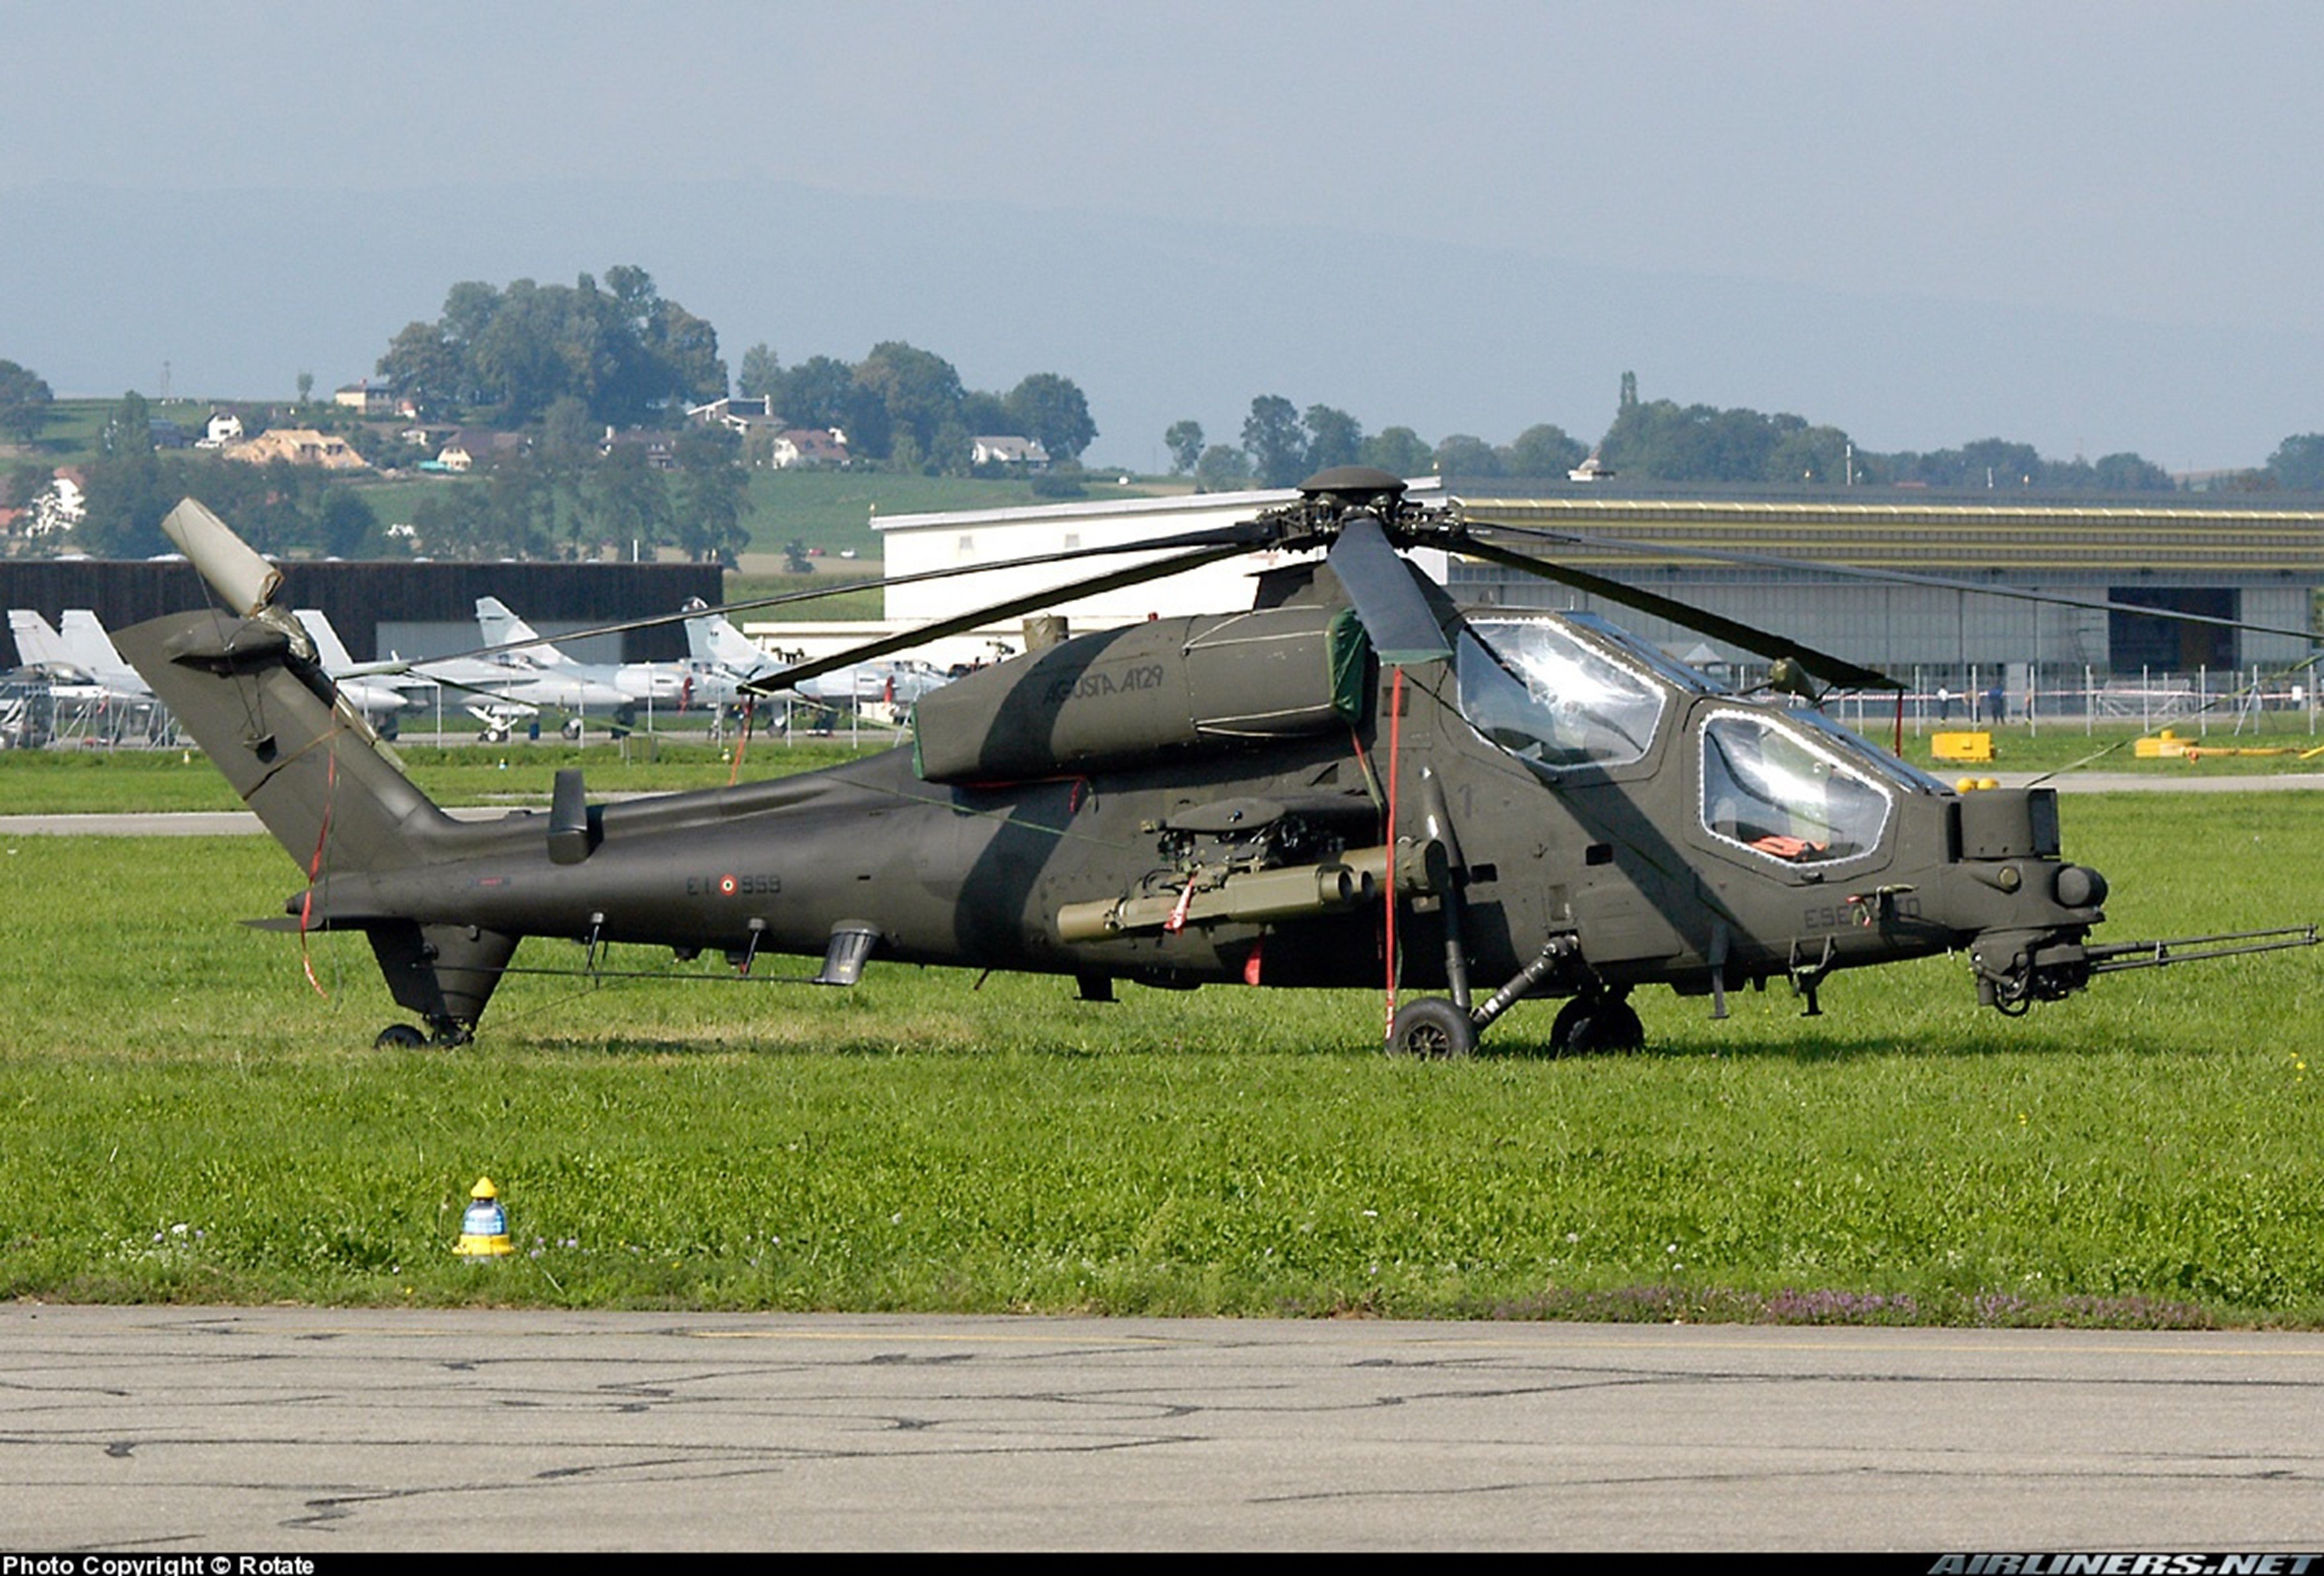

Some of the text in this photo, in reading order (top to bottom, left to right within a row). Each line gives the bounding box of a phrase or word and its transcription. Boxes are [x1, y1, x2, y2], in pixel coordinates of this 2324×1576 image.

[1042, 664, 1164, 705] AGUSTA A129
[741, 874, 781, 895] 959
